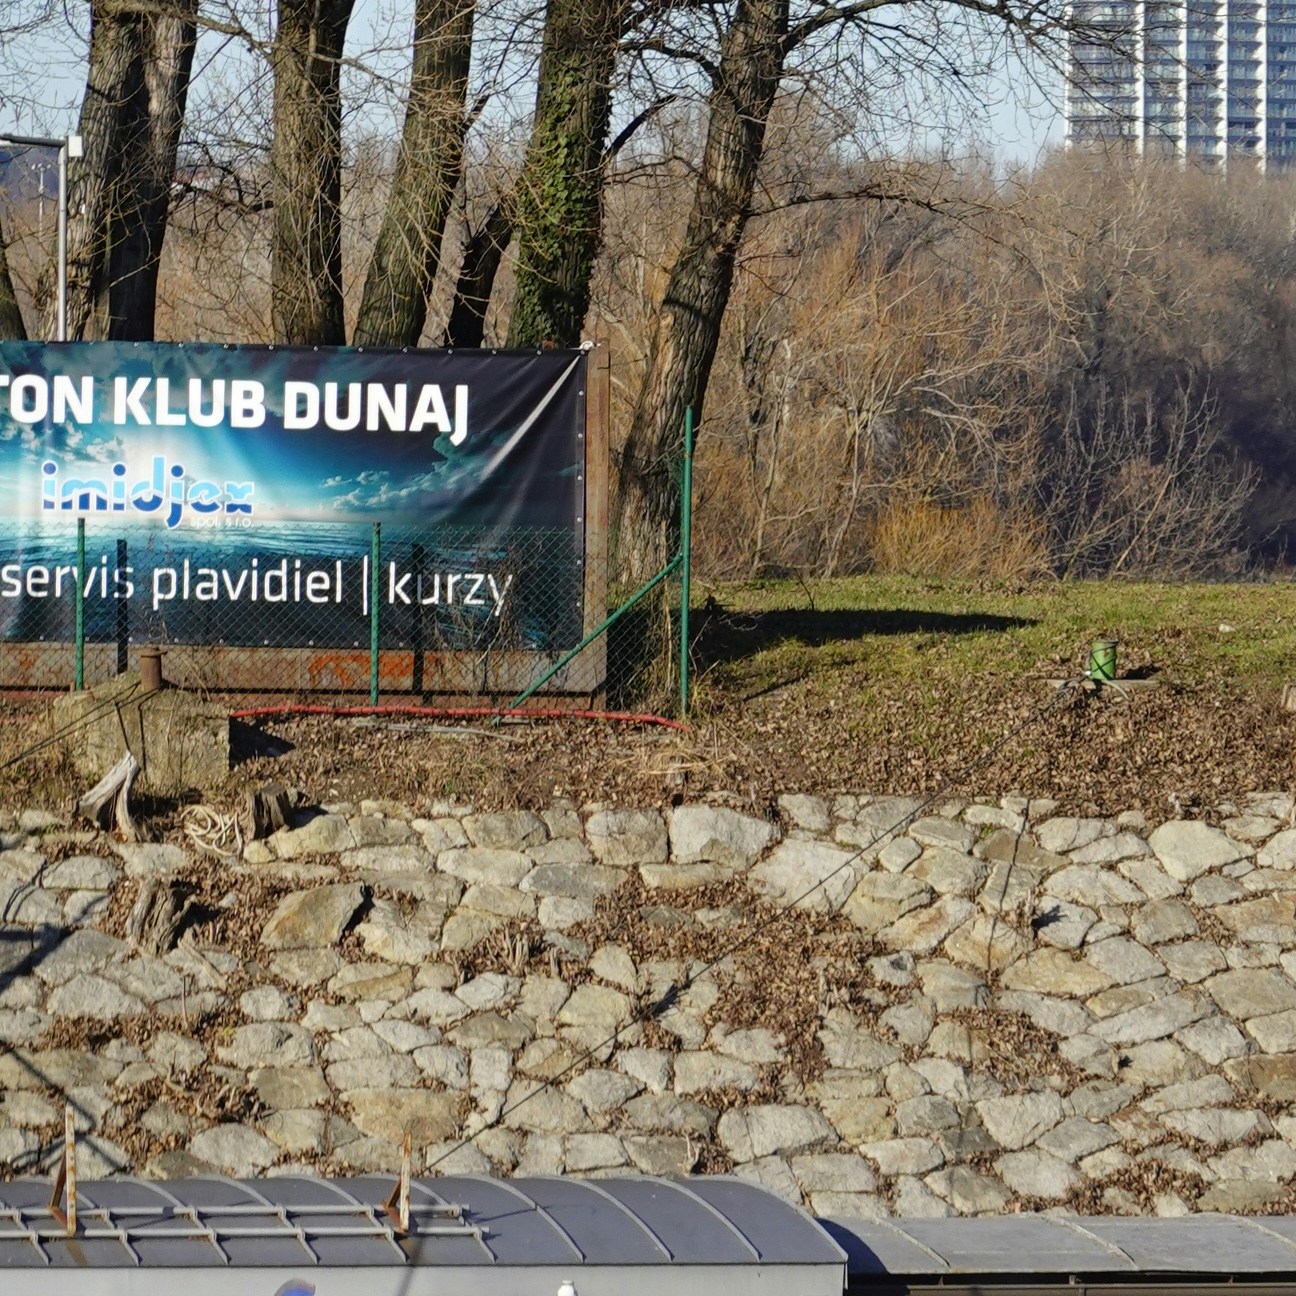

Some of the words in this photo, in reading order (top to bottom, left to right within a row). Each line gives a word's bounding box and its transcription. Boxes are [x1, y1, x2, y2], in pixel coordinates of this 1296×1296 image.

[0, 373, 94, 424] ON
[113, 376, 266, 429] KLUB
[283, 381, 469, 446] DUNAJ
[40, 455, 255, 529] imidjex
[1, 555, 135, 599] servis
[152, 557, 342, 611] plavidiel
[388, 561, 514, 617] kurzy
